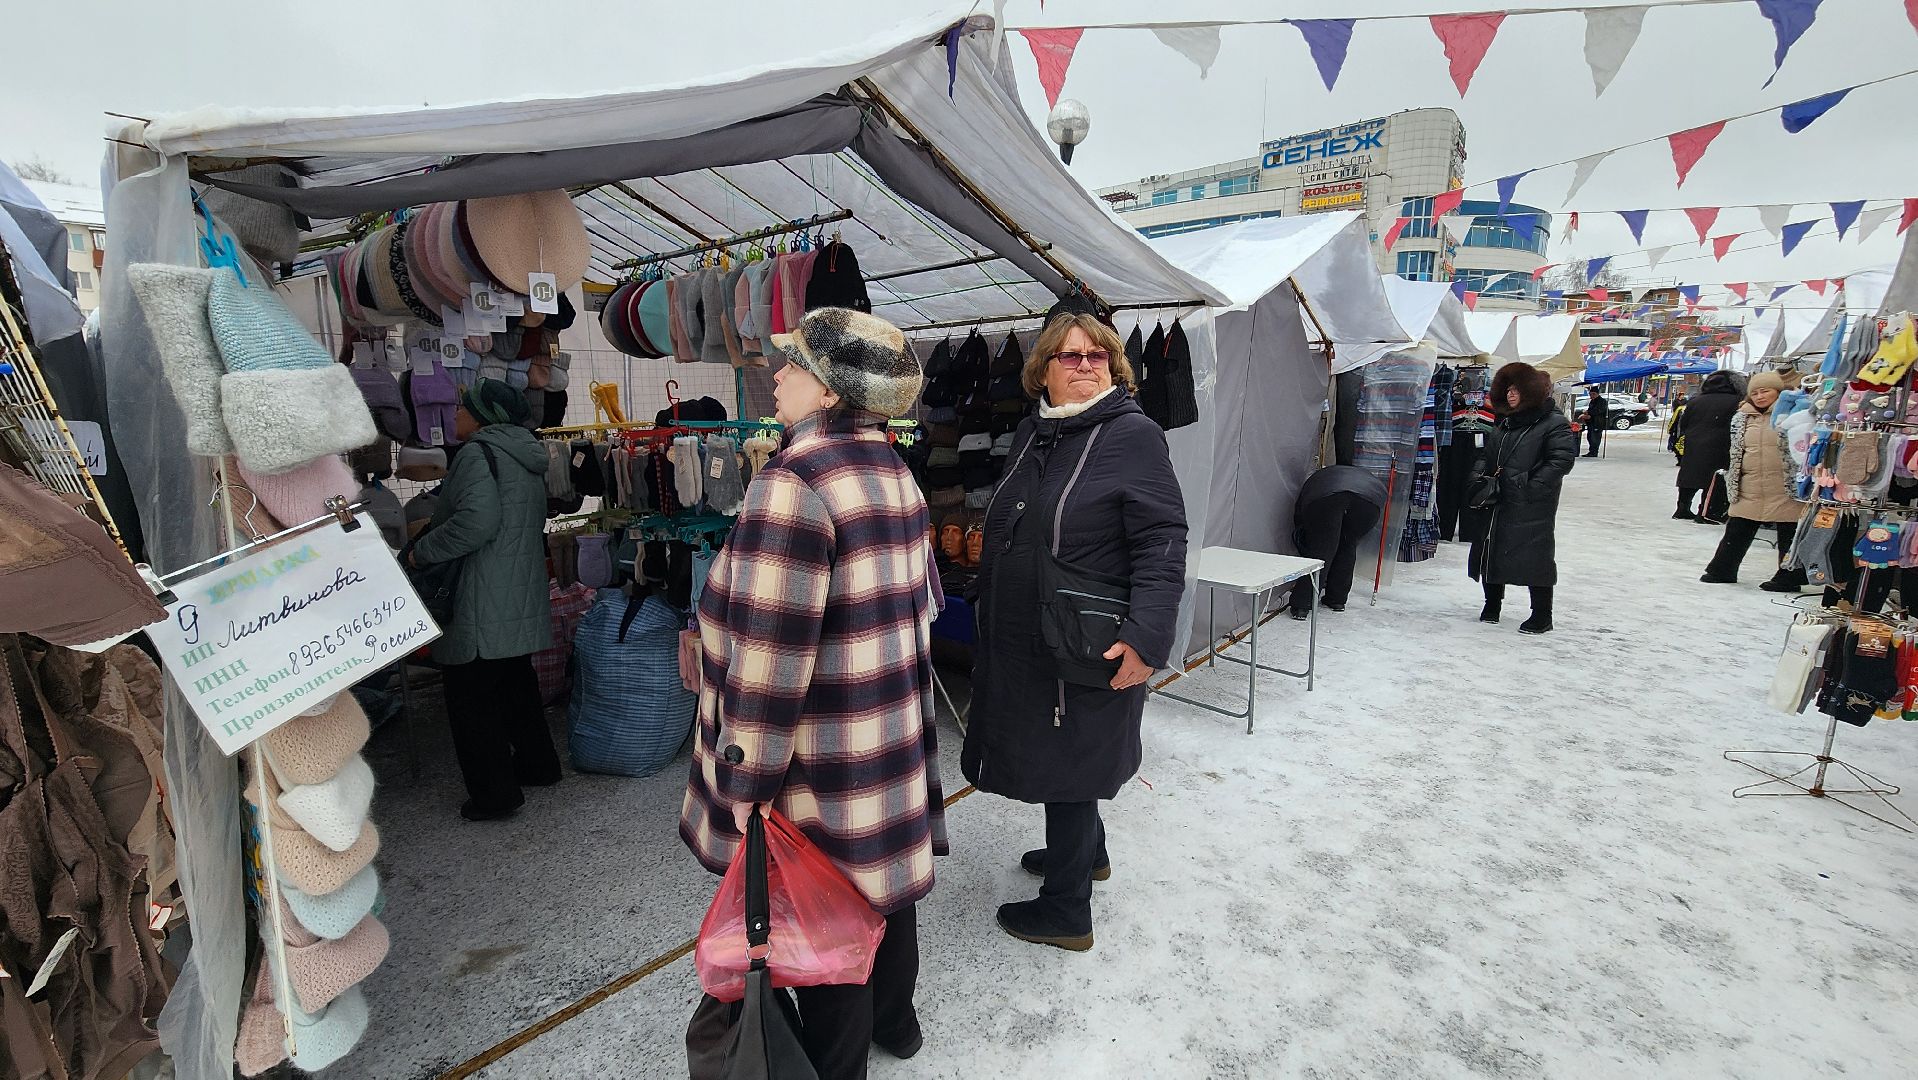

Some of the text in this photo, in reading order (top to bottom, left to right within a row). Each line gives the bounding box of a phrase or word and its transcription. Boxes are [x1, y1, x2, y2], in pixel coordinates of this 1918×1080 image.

[1263, 129, 1385, 168] СЕНЕЖ
[535, 286, 553, 299] JH
[180, 566, 366, 669] ИП Литвинова
[193, 657, 250, 696] ИНН
[206, 596, 406, 716] Телефон 89265466340
[221, 619, 428, 737] Производитель Россия
